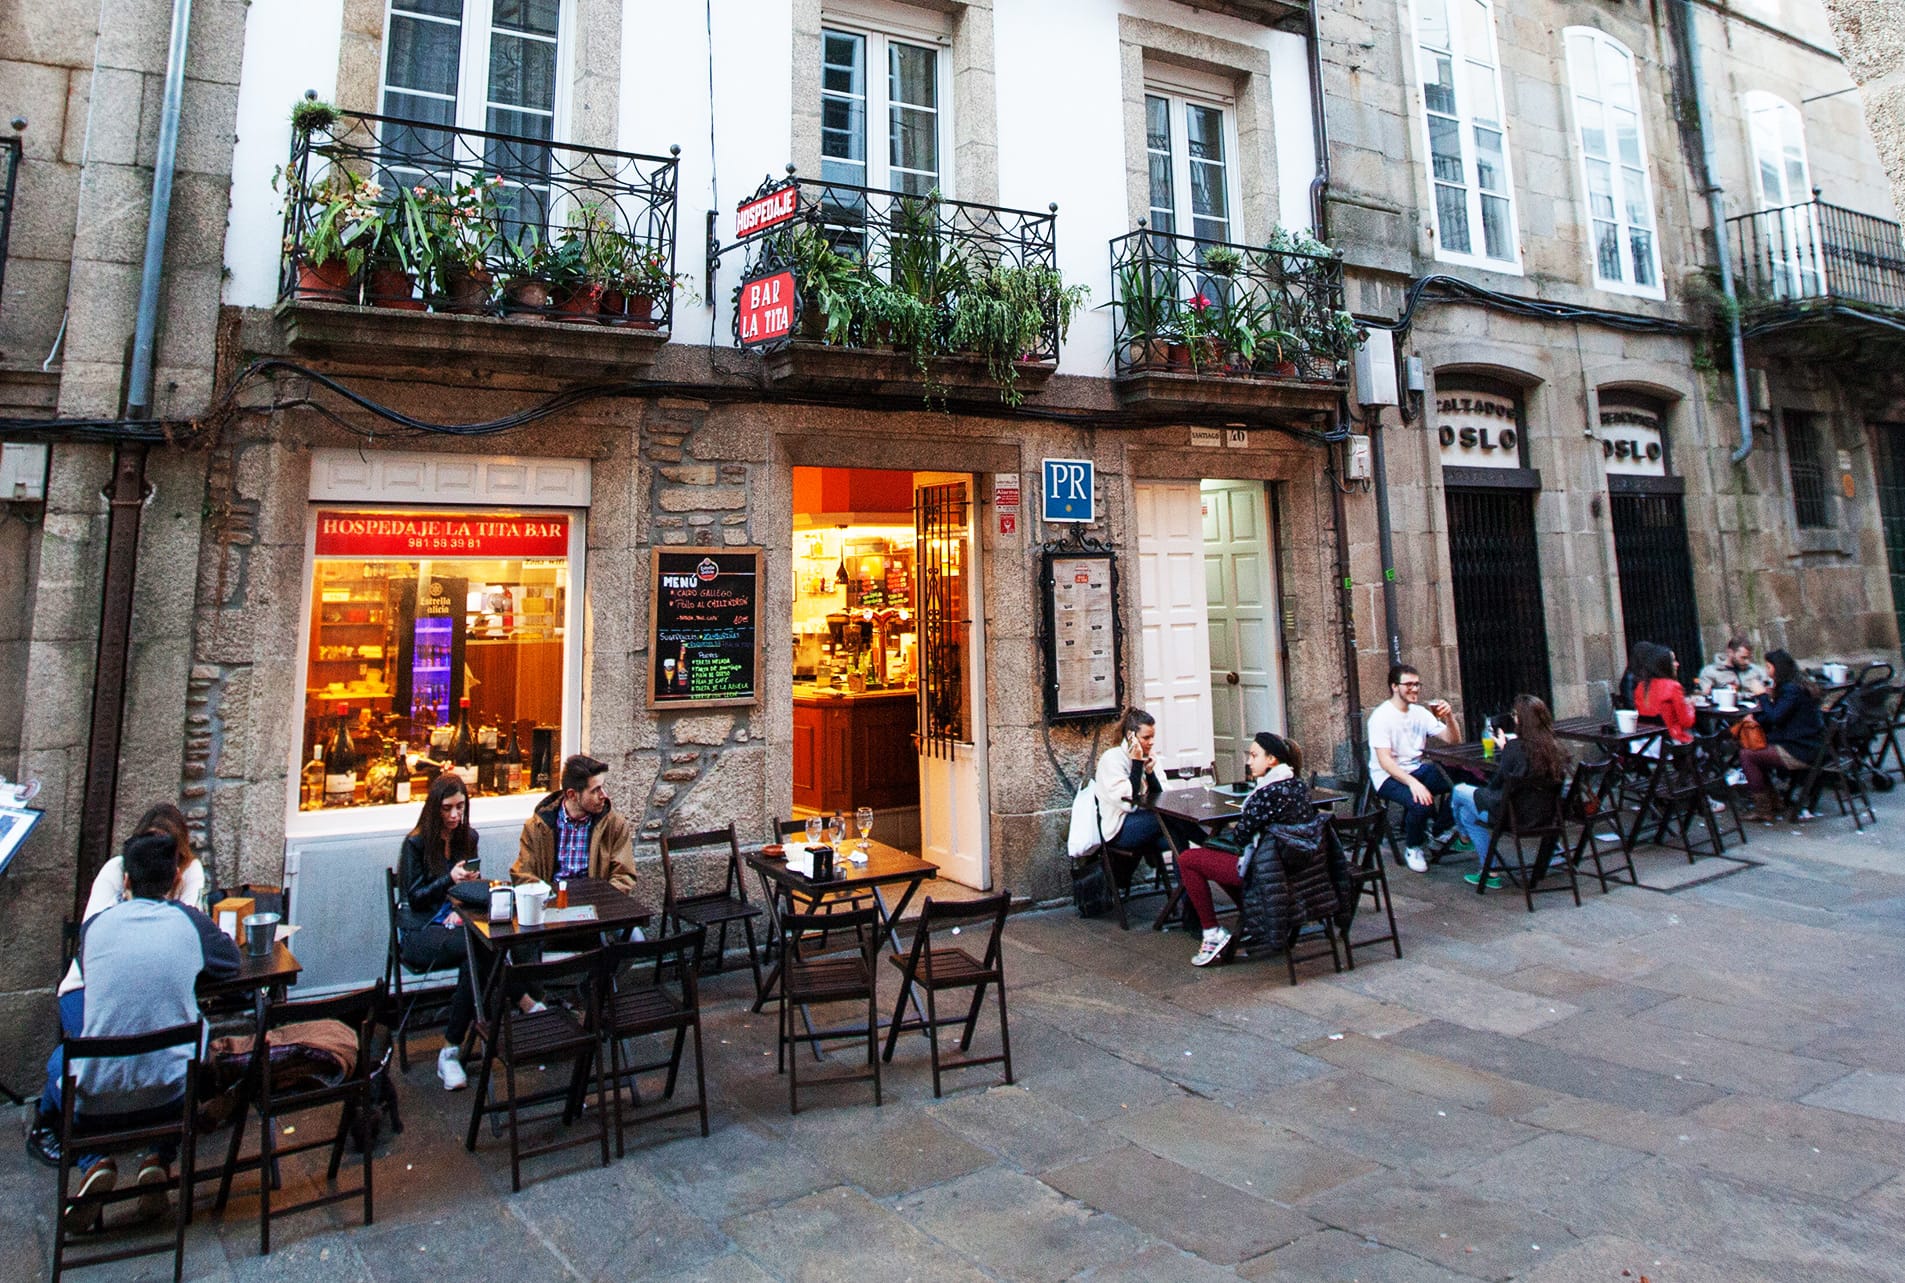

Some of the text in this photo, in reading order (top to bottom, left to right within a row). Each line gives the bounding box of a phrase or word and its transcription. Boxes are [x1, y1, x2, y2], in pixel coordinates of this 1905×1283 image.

[736, 190, 793, 233] HOSPEDAJE
[751, 279, 781, 310] BAR
[742, 305, 789, 339] LA TITA
[1439, 425, 1518, 449] OSLO
[1049, 463, 1088, 500] PR
[323, 518, 562, 538] HOSPEDAJE LA TITA BAR
[407, 537, 482, 548] 981 58 39 81
[663, 573, 698, 588] MENÚ
[700, 589, 733, 597] GALLEGO
